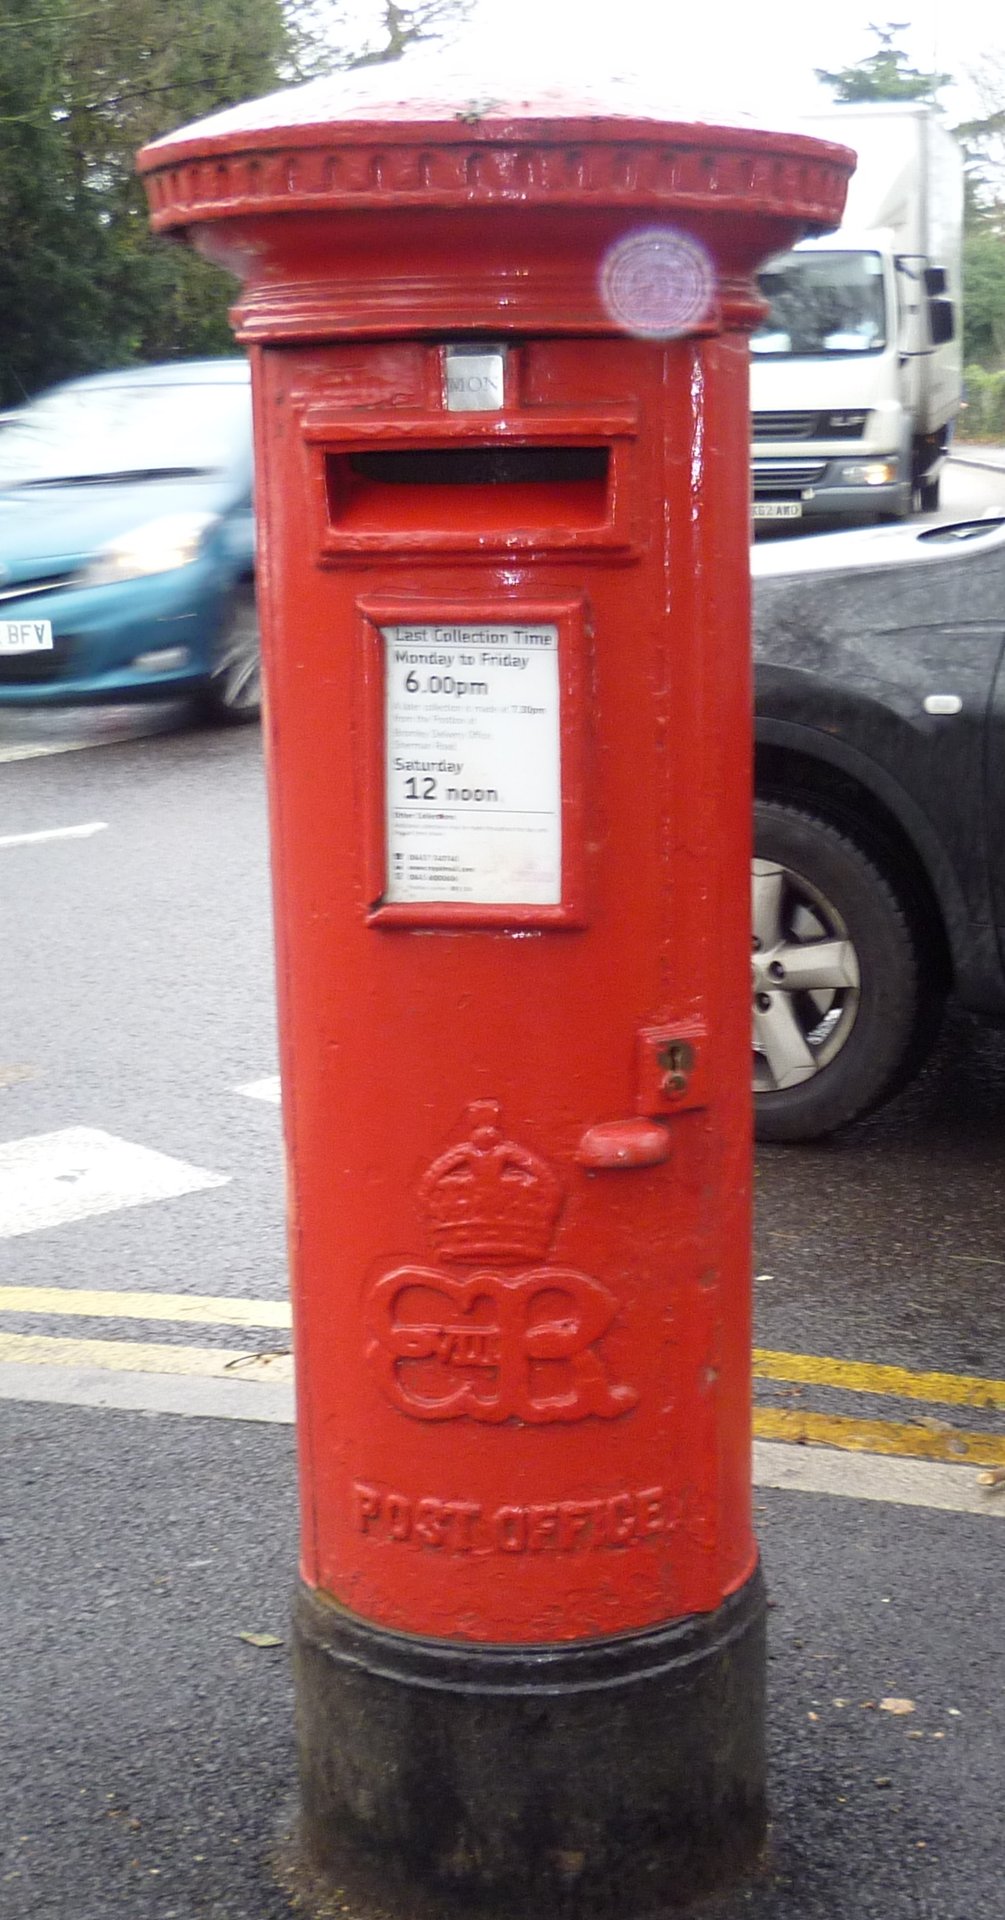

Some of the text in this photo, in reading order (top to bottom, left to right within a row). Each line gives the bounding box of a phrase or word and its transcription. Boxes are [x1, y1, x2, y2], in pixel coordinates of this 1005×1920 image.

[395, 628, 553, 646] Last Collection Time
[395, 651, 529, 669] Monday to Friday
[405, 671, 489, 698] 6.00pm
[394, 757, 464, 775] Saturday
[404, 776, 499, 802] 12 noon
[353, 1480, 665, 1554] POST OFFICE
